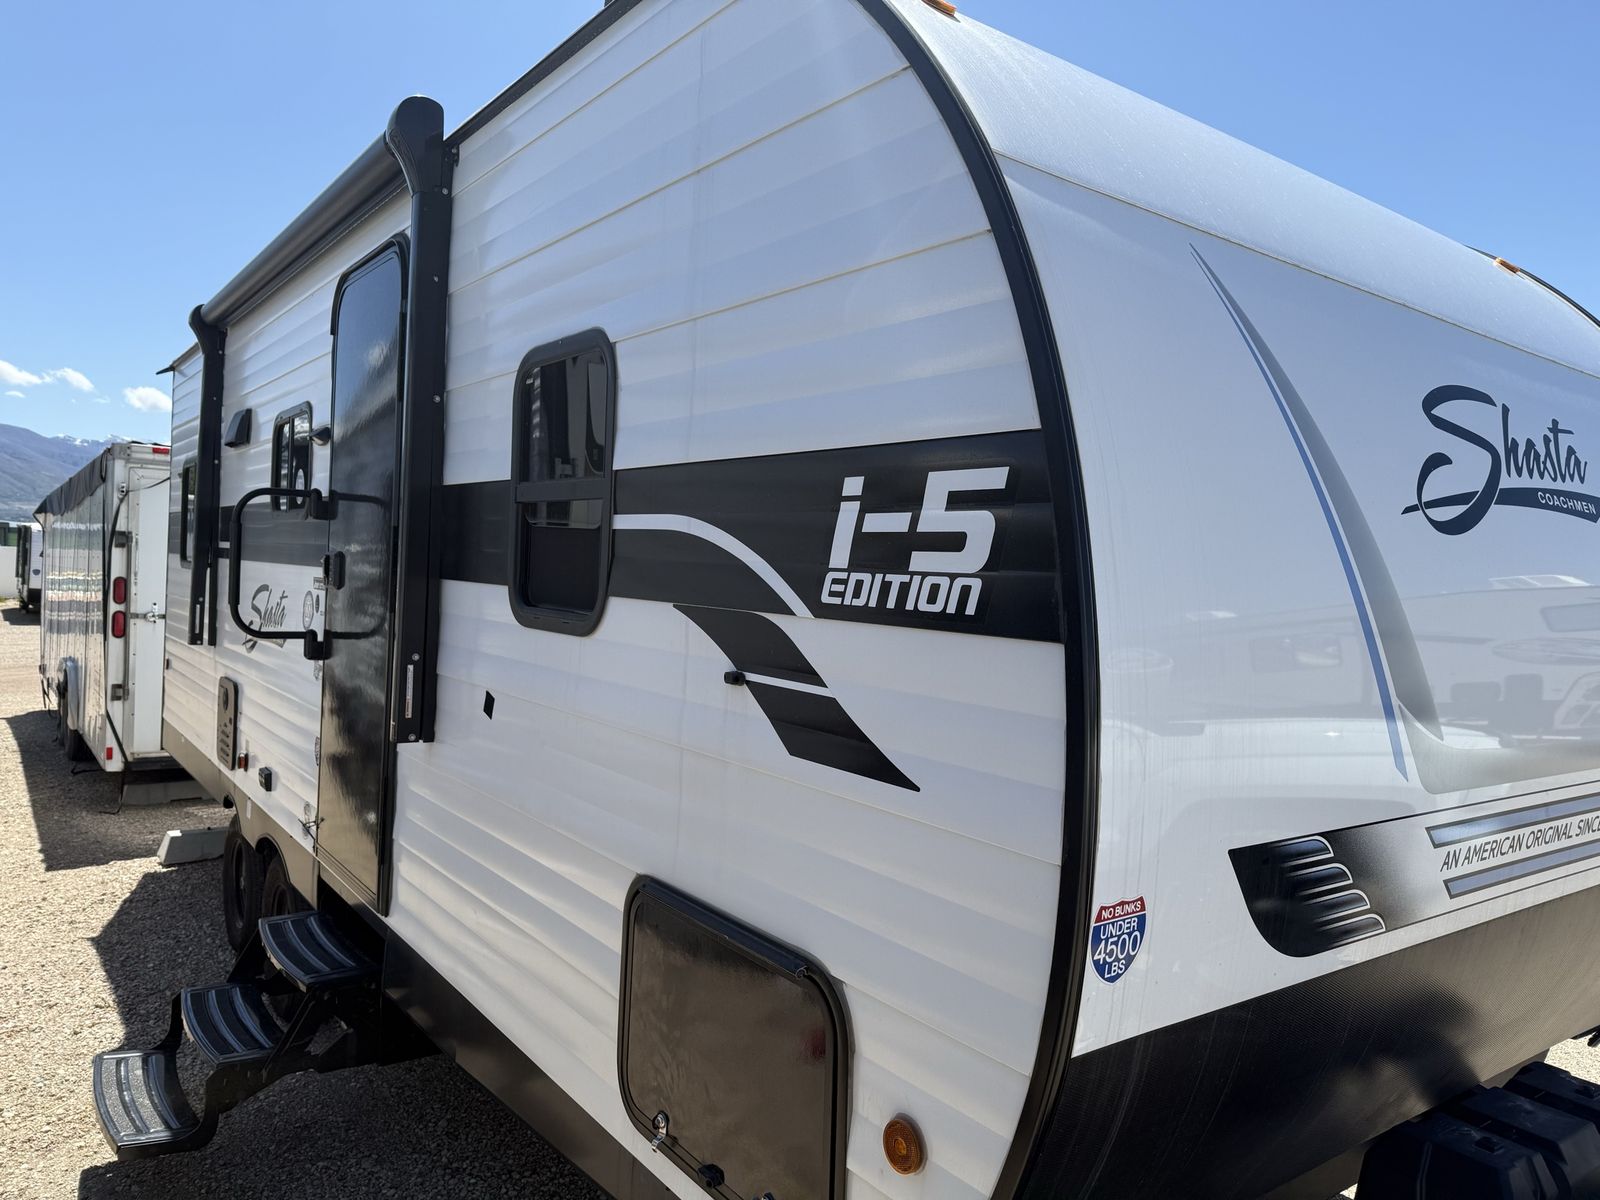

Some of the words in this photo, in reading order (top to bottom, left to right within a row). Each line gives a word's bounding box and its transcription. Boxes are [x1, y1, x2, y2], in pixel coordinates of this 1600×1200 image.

[1416, 384, 1588, 536] Shasta
[828, 466, 1010, 574] i-5
[1537, 491, 1597, 515] COACHMEN
[820, 571, 983, 616] EDITION
[243, 583, 288, 654] Shasta
[1440, 847, 1462, 872] AN
[1461, 833, 1525, 867] AMERICAN
[1525, 821, 1573, 850] ORIGINAL
[1100, 917, 1138, 939] UNDER
[1101, 908, 1114, 920] NO
[1115, 901, 1142, 917] BUNKS
[1093, 931, 1141, 965] 4500
[1104, 960, 1126, 978] LBS
